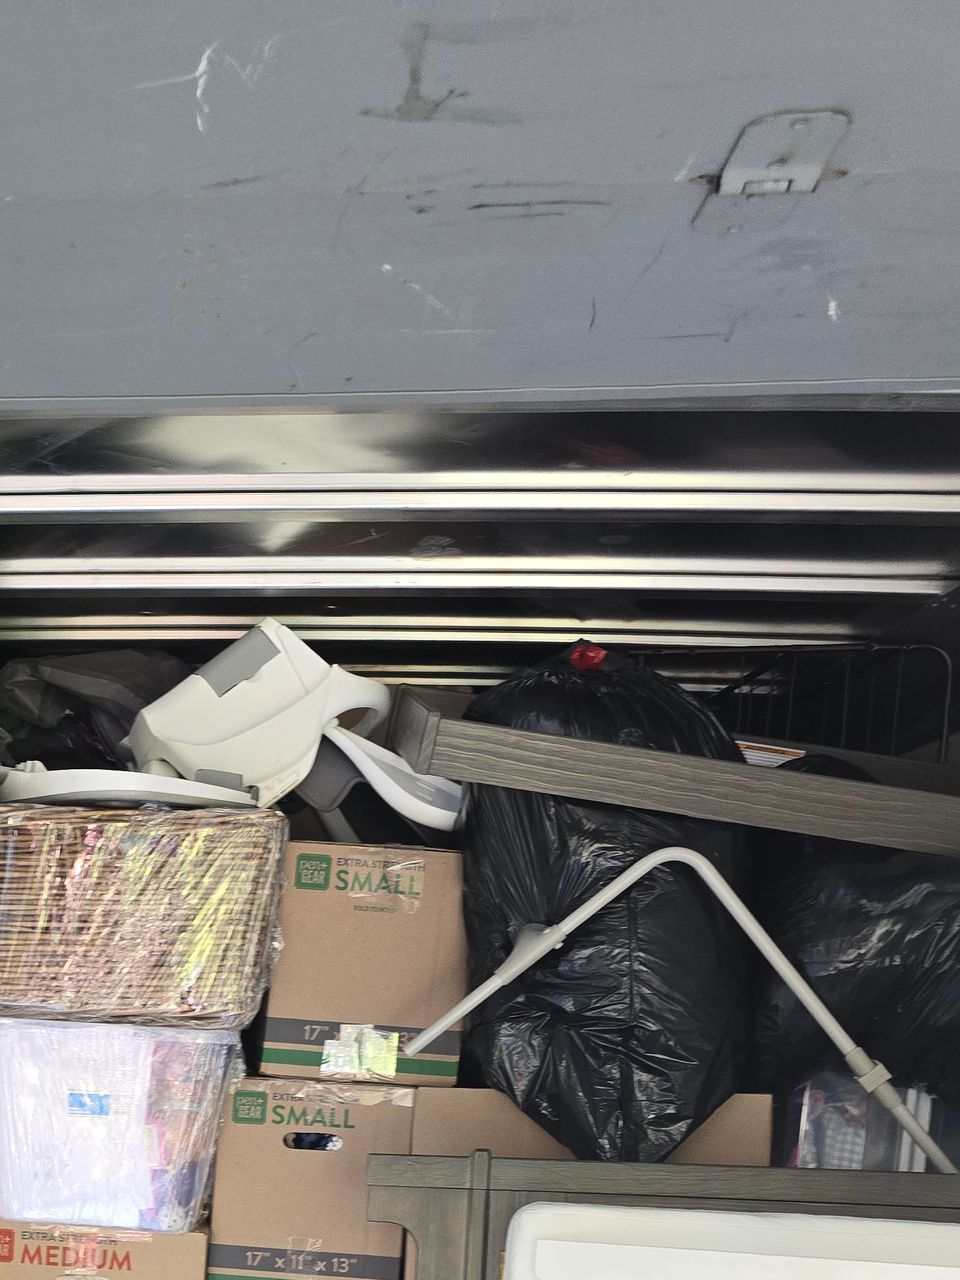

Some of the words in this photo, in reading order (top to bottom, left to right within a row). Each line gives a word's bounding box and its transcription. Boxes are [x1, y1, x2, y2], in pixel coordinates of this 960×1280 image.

[336, 857, 369, 868] EXTRA
[301, 870, 326, 884] GEAR
[335, 869, 421, 896] SMALL
[271, 1104, 356, 1128] SMALL
[21, 1231, 56, 1241] EXTRA
[20, 1244, 132, 1271] MEDIUM
[245, 1251, 271, 1266] 17"
[274, 1257, 286, 1269] x
[315, 1260, 328, 1272] x
[331, 1257, 358, 1273] 13"
